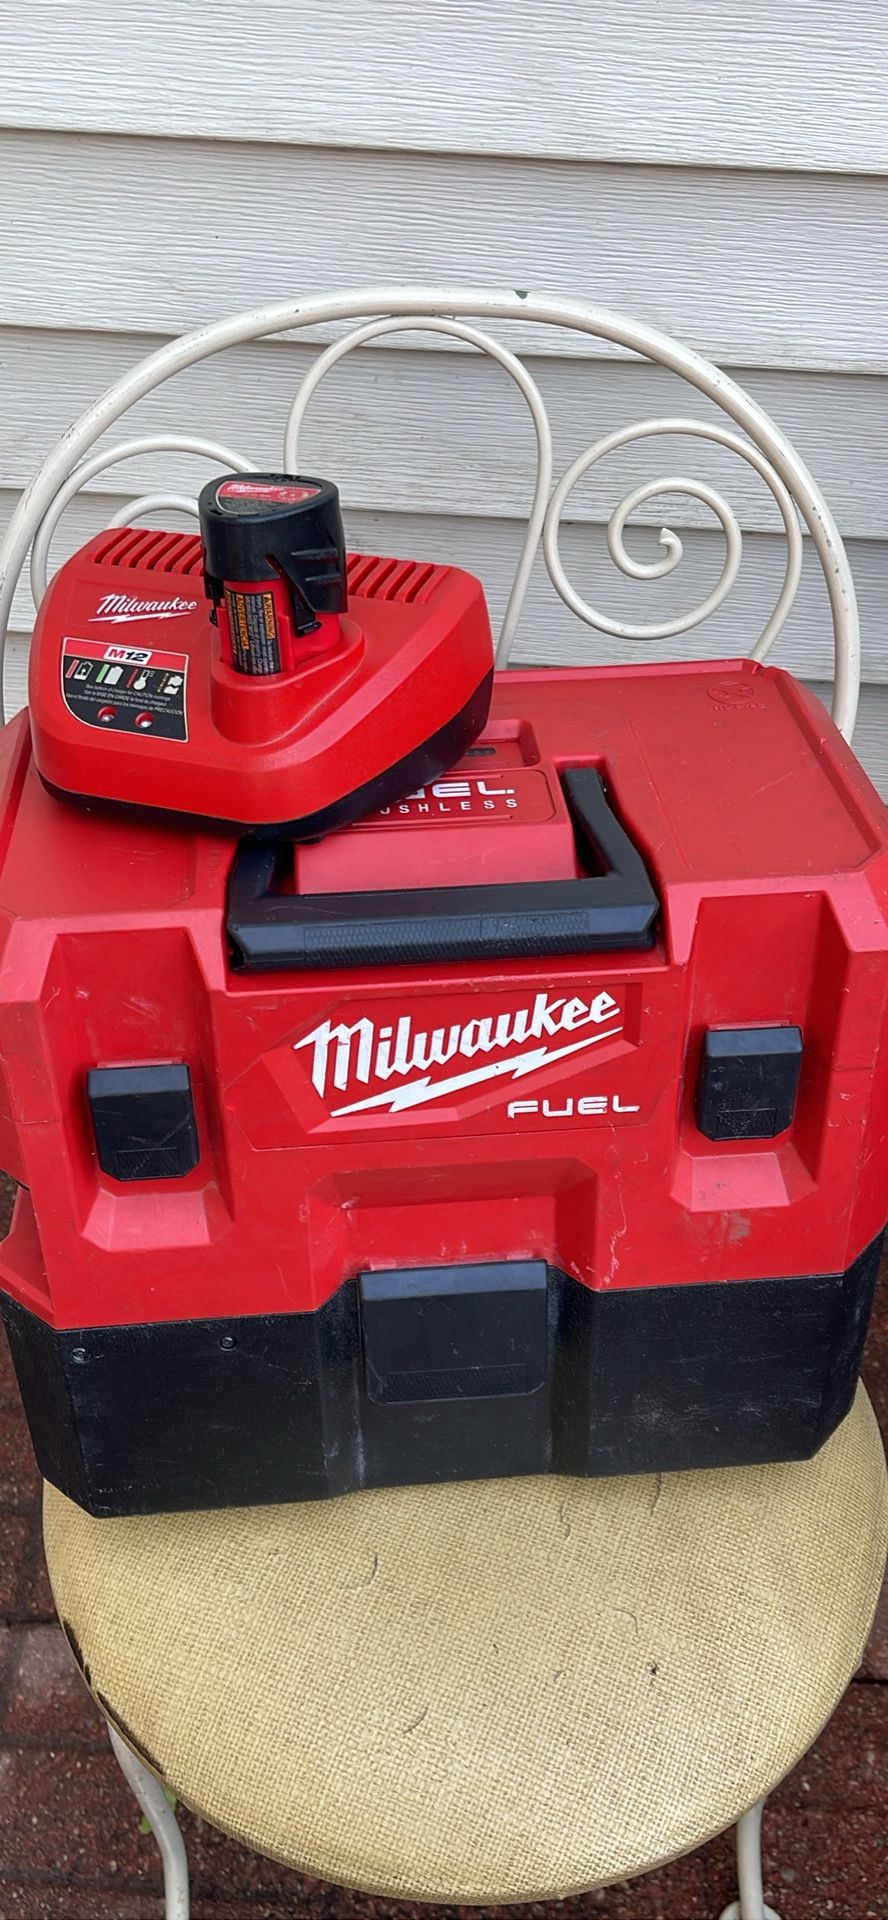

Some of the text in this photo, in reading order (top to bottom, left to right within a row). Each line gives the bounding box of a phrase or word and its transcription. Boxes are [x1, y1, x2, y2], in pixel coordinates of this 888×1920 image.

[96, 594, 198, 615] Milwaukee
[264, 602, 276, 638] WARNING
[107, 648, 149, 662] M12
[380, 798, 518, 814] USHLESS
[293, 991, 621, 1099] Milwaukee
[507, 1094, 641, 1119] FUEL
